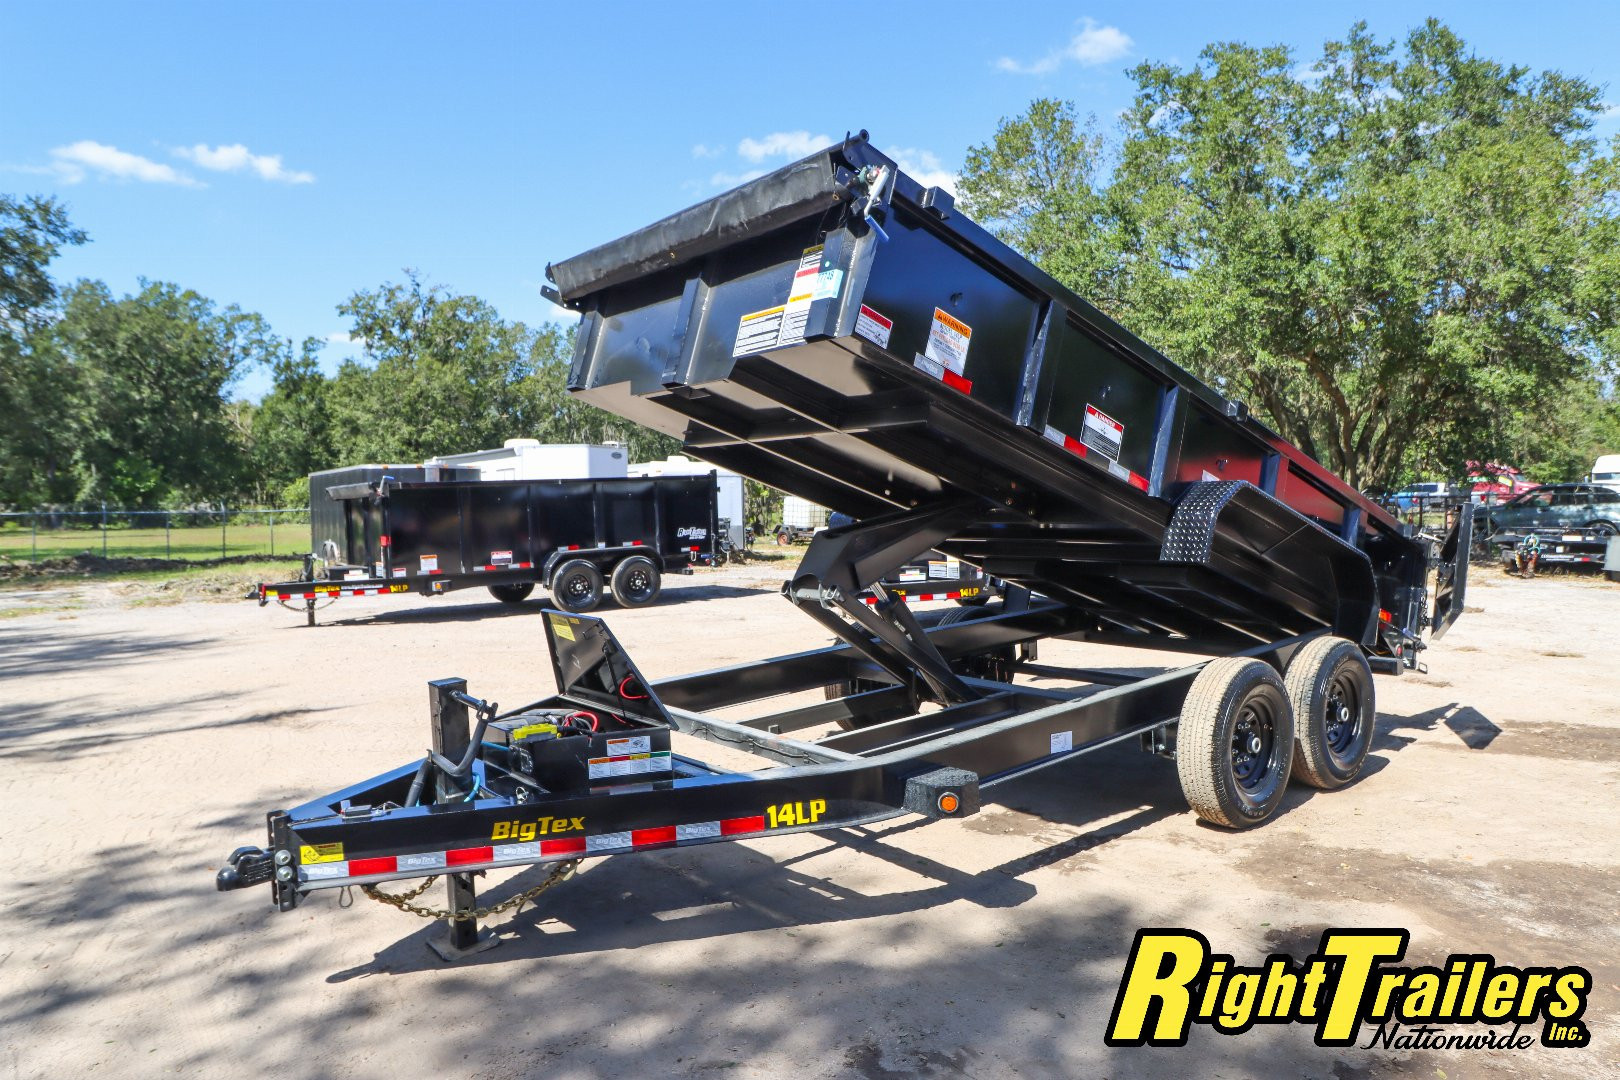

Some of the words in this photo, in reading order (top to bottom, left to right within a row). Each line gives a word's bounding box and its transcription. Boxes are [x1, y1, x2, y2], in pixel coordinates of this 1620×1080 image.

[943, 316, 968, 335] WARNING
[767, 799, 826, 829] 14LP
[491, 816, 587, 842] BigTex
